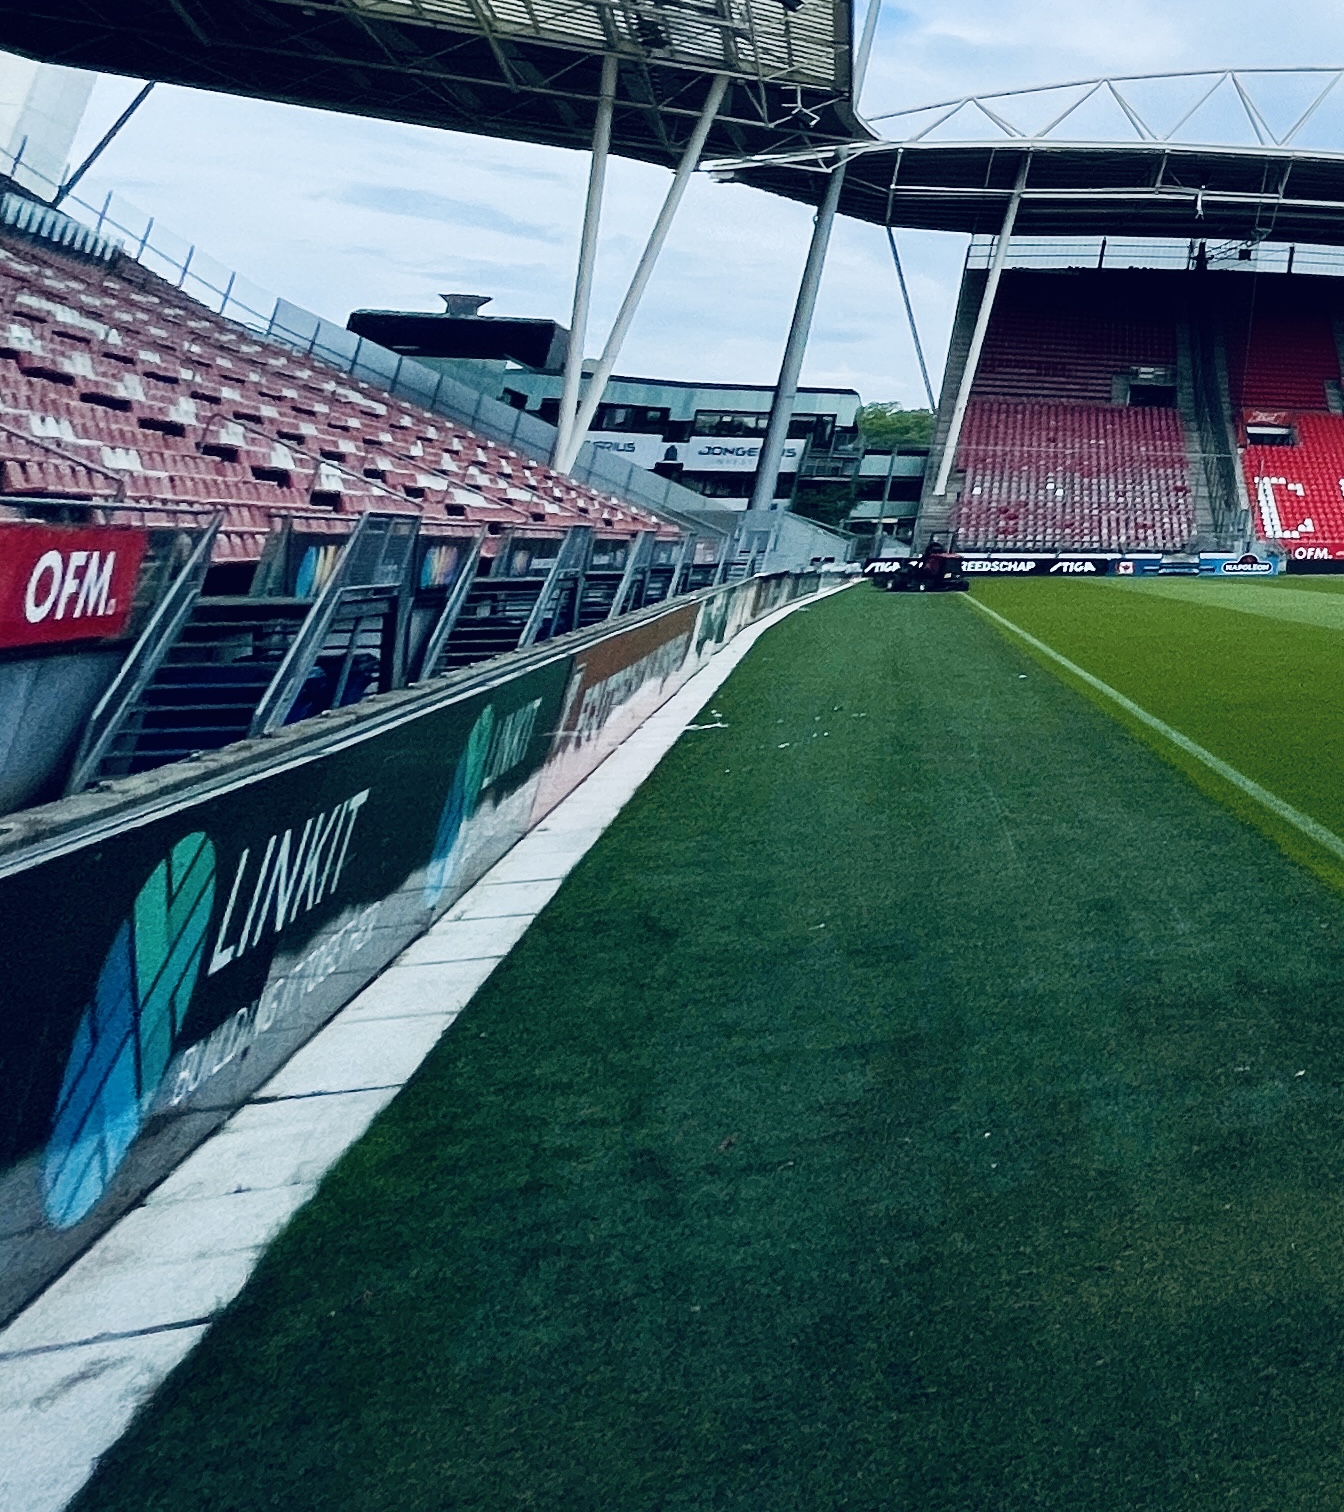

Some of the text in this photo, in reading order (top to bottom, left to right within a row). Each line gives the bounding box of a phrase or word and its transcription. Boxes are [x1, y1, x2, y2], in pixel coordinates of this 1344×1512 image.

[698, 446, 797, 458] JONGES
[1050, 561, 1096, 573] STIGA
[1225, 564, 1271, 573] NAPOLEON
[24, 548, 117, 625] OFM.
[207, 788, 371, 976] LINKIT
